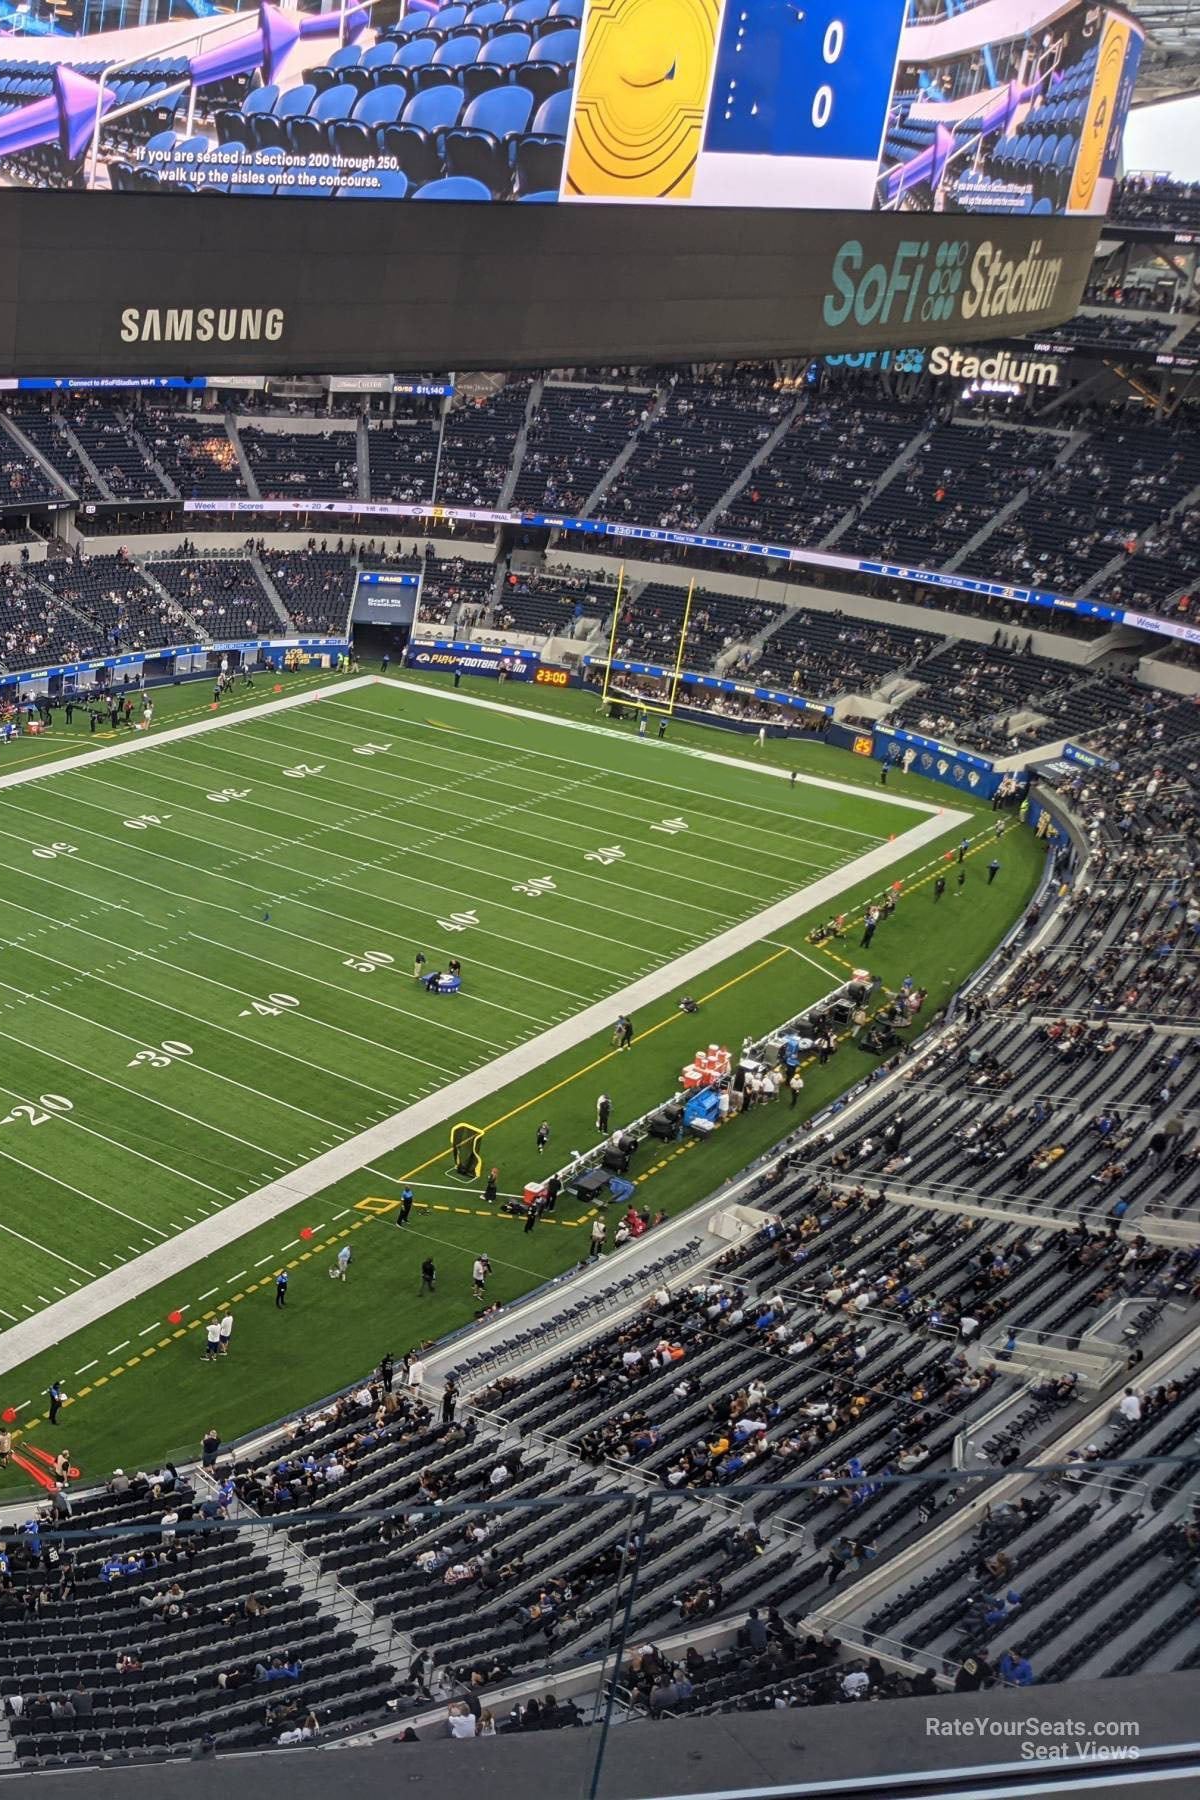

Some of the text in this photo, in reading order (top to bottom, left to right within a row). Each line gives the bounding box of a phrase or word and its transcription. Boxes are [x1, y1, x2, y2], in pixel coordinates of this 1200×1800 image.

[823, 20, 843, 64] 0
[812, 85, 832, 128] 0
[136, 149, 399, 172] If you are seated in Sections 200 through 250,
[158, 168, 381, 188] walk up the aisles onto the concourse.
[823, 239, 1062, 327] SoFi Stadium
[120, 308, 284, 342] SAMSUNG
[929, 346, 1058, 386] Stadium
[417, 386, 444, 395] $11,140
[238, 502, 264, 510] Scores
[378, 575, 403, 583] RAMS
[536, 669, 567, 684] 23:00
[855, 736, 871, 750] 25
[648, 819, 689, 835] 10
[32, 842, 80, 860] 50
[584, 846, 628, 865] 20
[512, 877, 558, 898] 30
[436, 910, 481, 933] 40
[341, 949, 395, 974] 50
[249, 992, 300, 1018] 40
[140, 1040, 195, 1068] 30
[11, 1093, 74, 1127] 20
